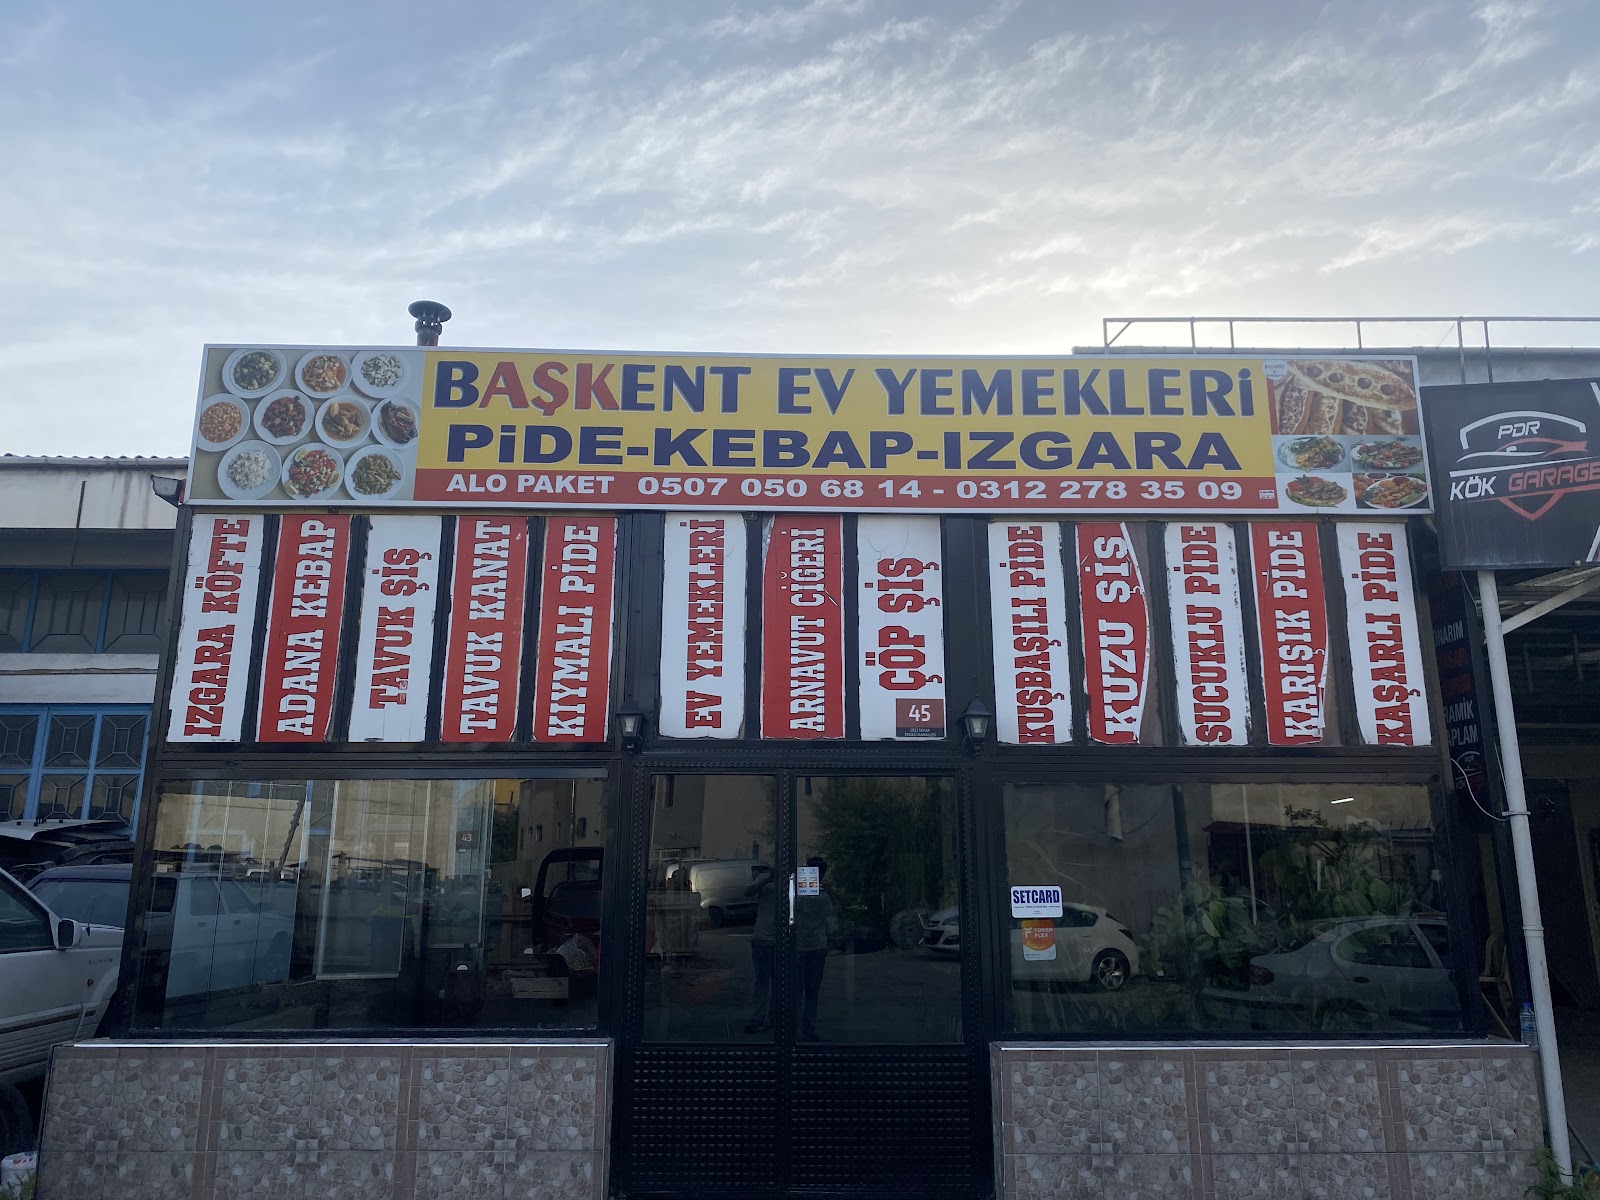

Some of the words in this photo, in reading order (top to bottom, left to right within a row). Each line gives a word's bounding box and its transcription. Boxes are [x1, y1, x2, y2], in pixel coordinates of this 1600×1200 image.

[434, 360, 752, 416] BAŞKENT
[777, 367, 854, 416] EV
[1498, 420, 1541, 439] PDR
[446, 474, 507, 493] ALO
[517, 475, 614, 495] PAKET
[637, 477, 728, 496] 0507
[740, 478, 808, 498] 050
[820, 479, 865, 498] 68
[878, 480, 921, 498] 14
[955, 481, 1047, 499] 0312
[1059, 481, 1128, 499] 278
[1140, 481, 1185, 499] 35
[1197, 481, 1242, 499] 09
[1449, 475, 1497, 501] KÖK
[1508, 461, 1600, 492] GARAGE
[194, 518, 250, 614] KÖFTE
[290, 518, 336, 618] KEBAP
[370, 548, 432, 596] ŞİŞ
[468, 520, 511, 621] KANAT
[551, 524, 600, 594] PİDE
[864, 557, 940, 613] ŞİŞ
[999, 525, 1046, 588] PİDE
[1173, 526, 1222, 595] PİDE
[1261, 530, 1309, 600] PİDE
[1351, 532, 1399, 602] PİDE
[679, 518, 725, 681] YEMEKLERİ
[184, 624, 235, 737] IZGARA
[276, 629, 324, 736] ADANA
[368, 606, 415, 709] TAVUK
[459, 631, 504, 734] TAVUK
[547, 605, 594, 737] KIYMALI
[789, 615, 825, 732] ARNAVUT
[865, 625, 943, 691] ÇÖP
[1010, 597, 1065, 743] KUŞBAŞILI
[1098, 619, 1139, 736] KUZU
[1186, 604, 1233, 743] SUCUKLU
[1273, 609, 1325, 738] KARIŞIK
[1365, 612, 1421, 746] KAŞARLI
[685, 690, 722, 729] EV
[908, 704, 931, 722] 45
[1012, 889, 1060, 904] SETCARD
